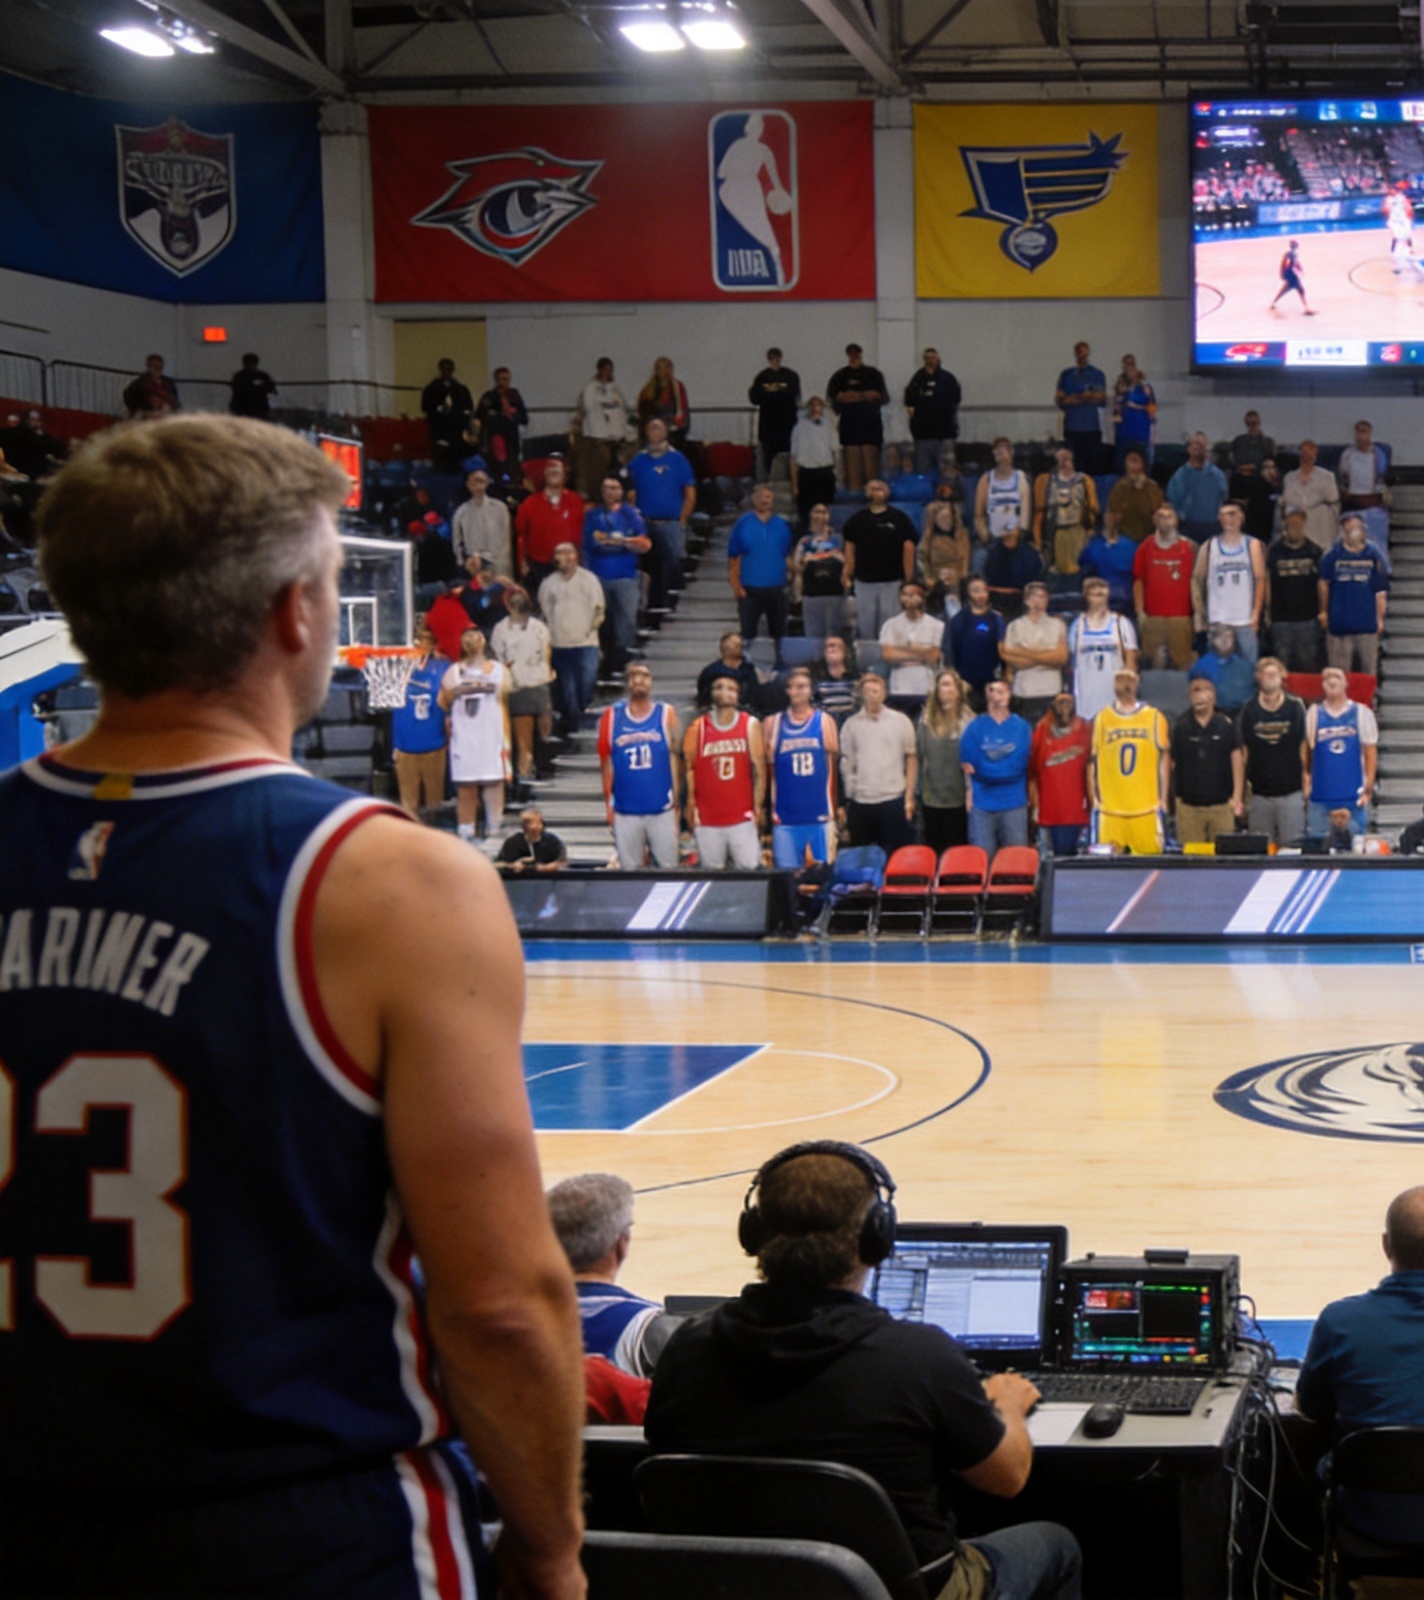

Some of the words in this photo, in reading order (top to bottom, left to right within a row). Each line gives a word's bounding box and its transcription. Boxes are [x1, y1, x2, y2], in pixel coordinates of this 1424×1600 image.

[1120, 743, 1137, 777] 0
[0, 907, 210, 1017] ARINER
[0, 1051, 193, 1339] 3
